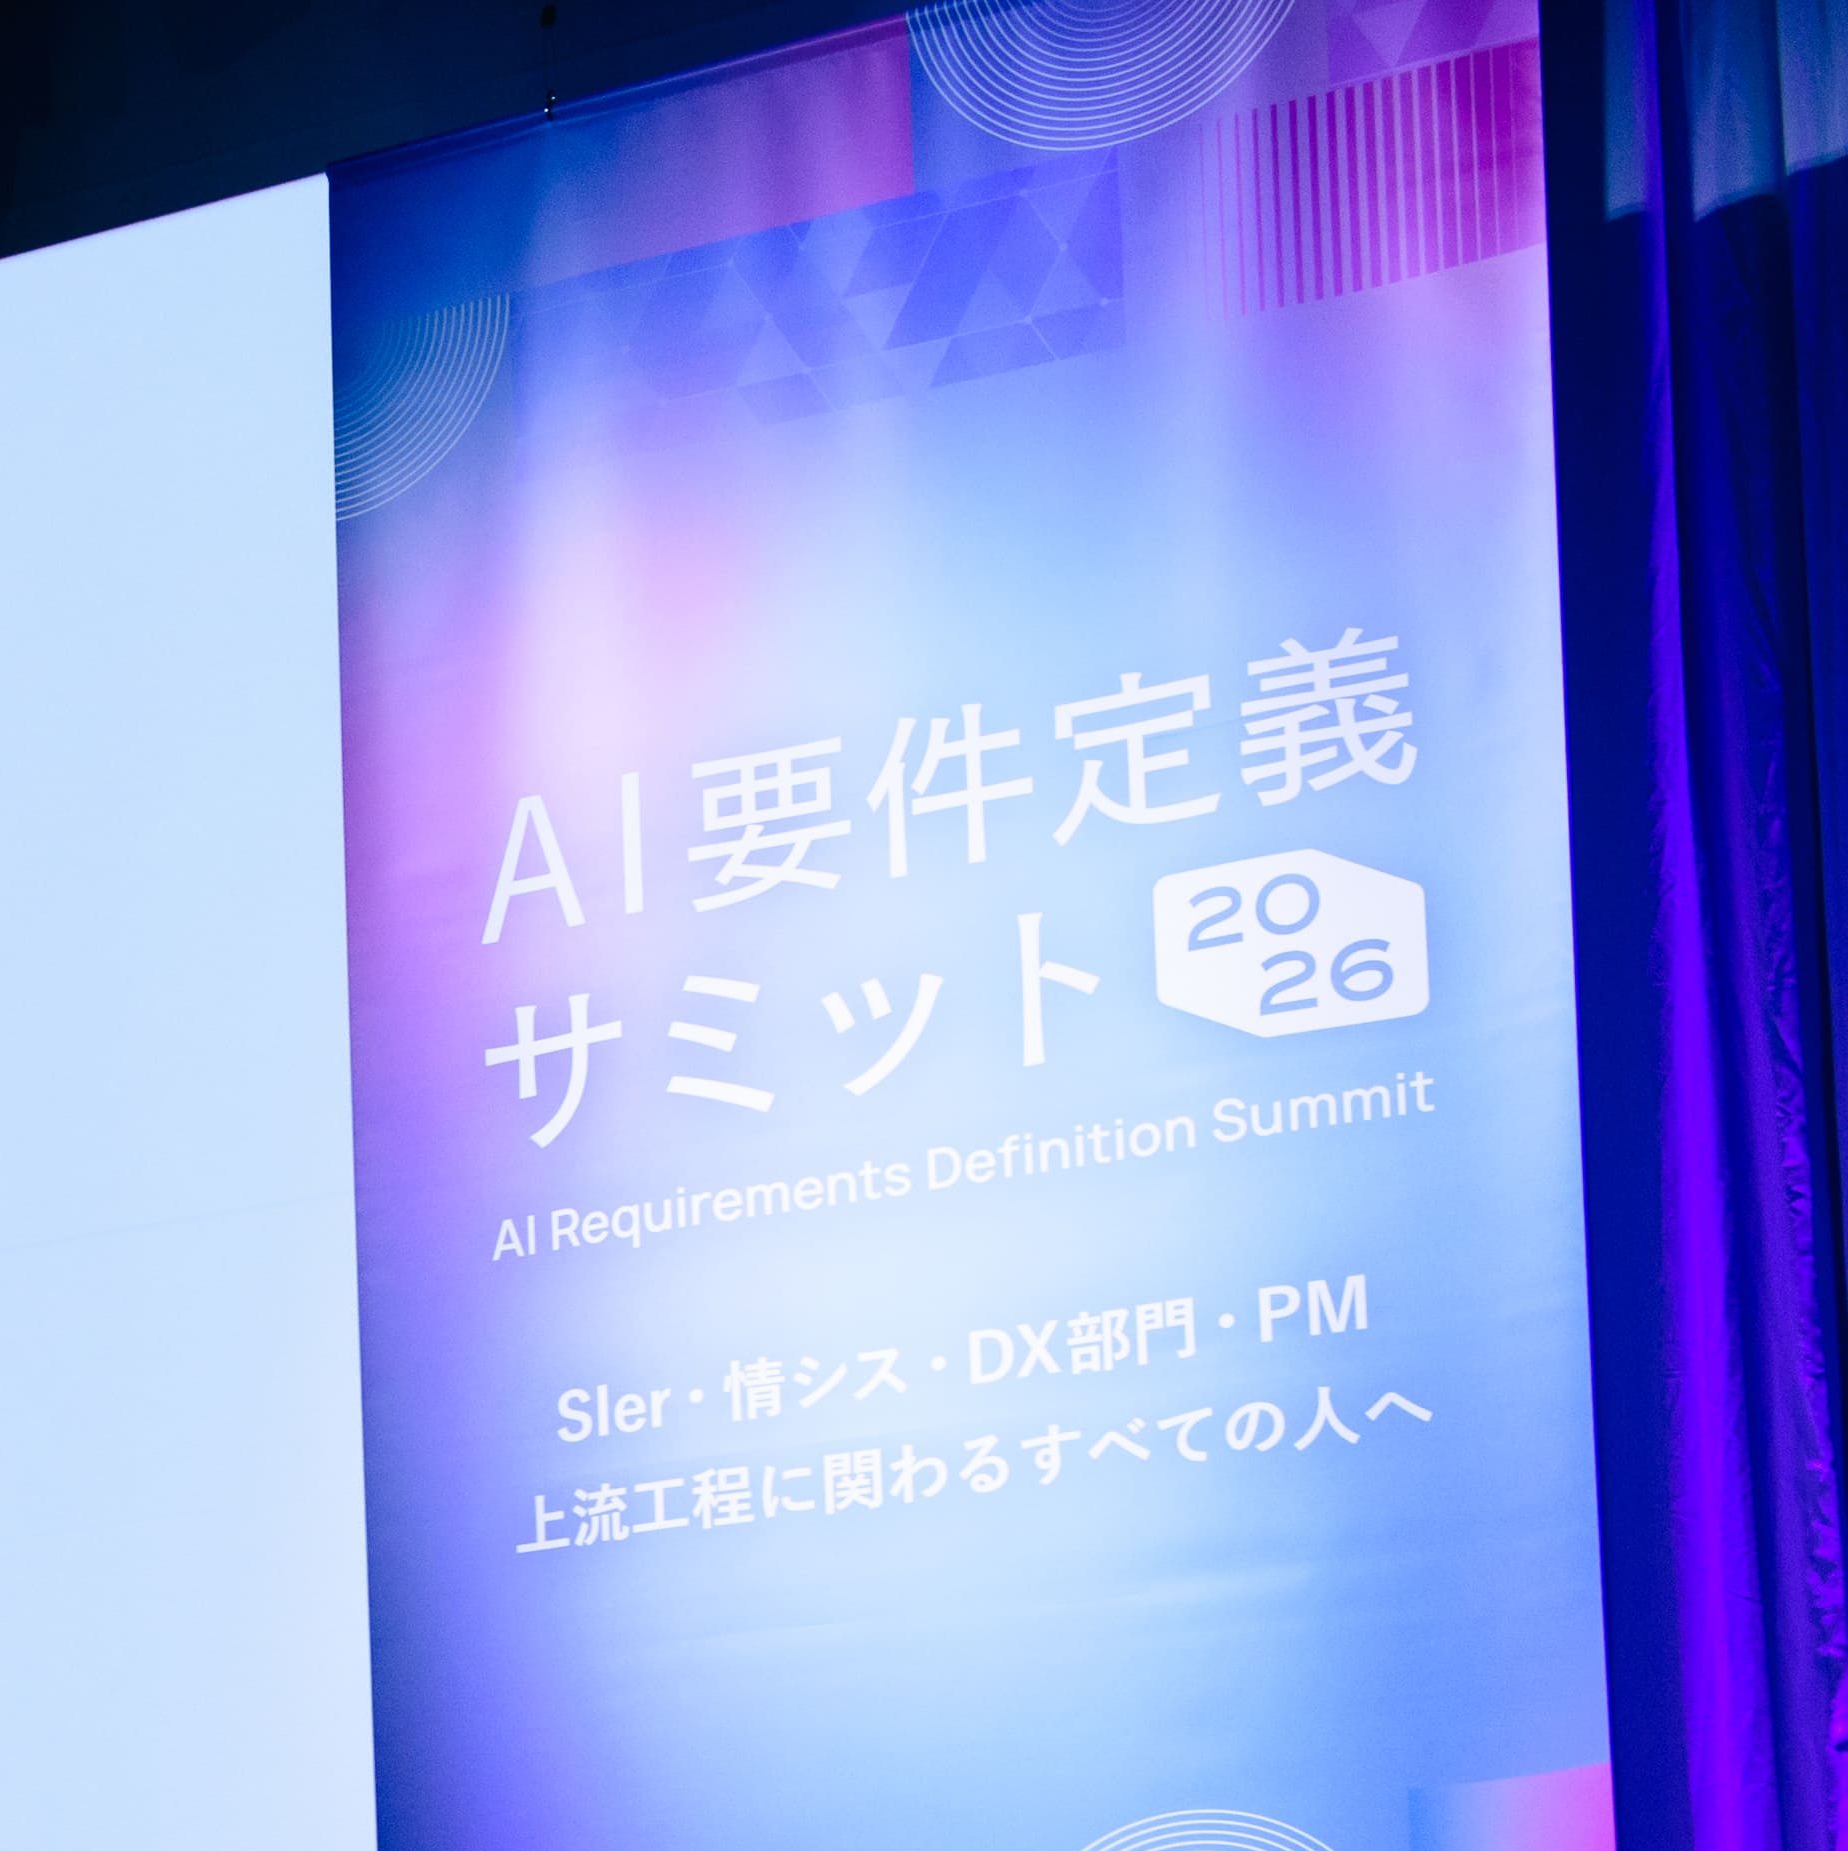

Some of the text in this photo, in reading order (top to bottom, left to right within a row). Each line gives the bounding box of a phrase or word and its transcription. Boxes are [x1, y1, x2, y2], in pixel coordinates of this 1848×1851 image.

[481, 627, 1419, 944] AI要件定義
[1186, 872, 1320, 951] 20
[1258, 938, 1394, 1016] 26
[484, 911, 1100, 1148] サミット
[492, 1069, 1436, 1261] AI Requirements Definition Summit
[515, 1386, 1434, 1554] 上流工程に関わるすべての人へ
